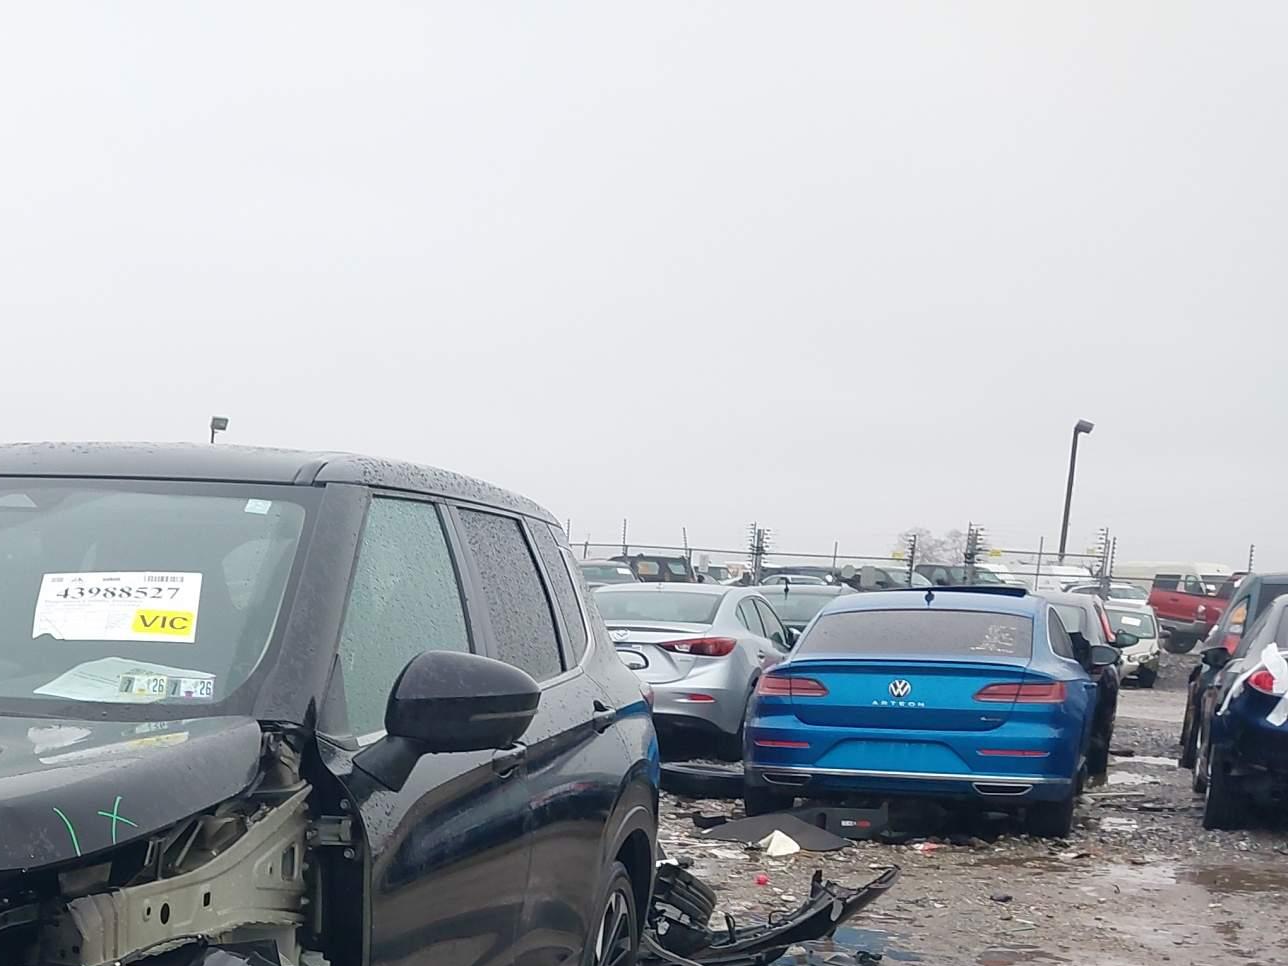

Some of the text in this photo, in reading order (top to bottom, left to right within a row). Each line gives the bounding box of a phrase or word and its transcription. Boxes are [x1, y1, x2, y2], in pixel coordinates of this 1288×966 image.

[55, 586, 180, 599] 43988527
[139, 614, 189, 630] VIC
[152, 678, 165, 693] 26
[199, 680, 212, 696] 26
